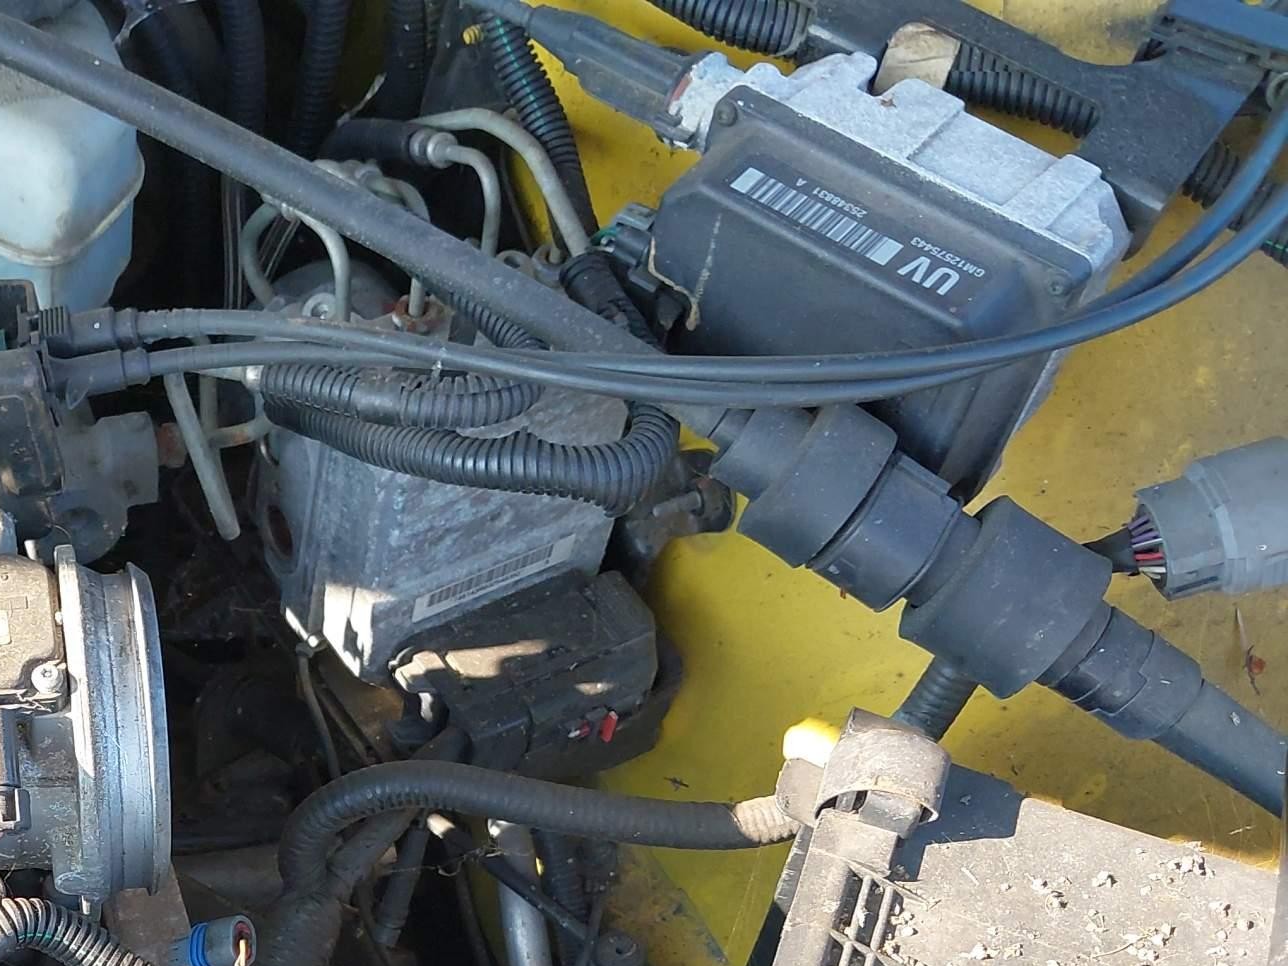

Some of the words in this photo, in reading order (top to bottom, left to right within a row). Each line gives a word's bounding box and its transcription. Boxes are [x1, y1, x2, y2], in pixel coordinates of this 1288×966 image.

[795, 178, 808, 187] A
[897, 256, 960, 296] UV
[910, 237, 985, 277] GM12575443
